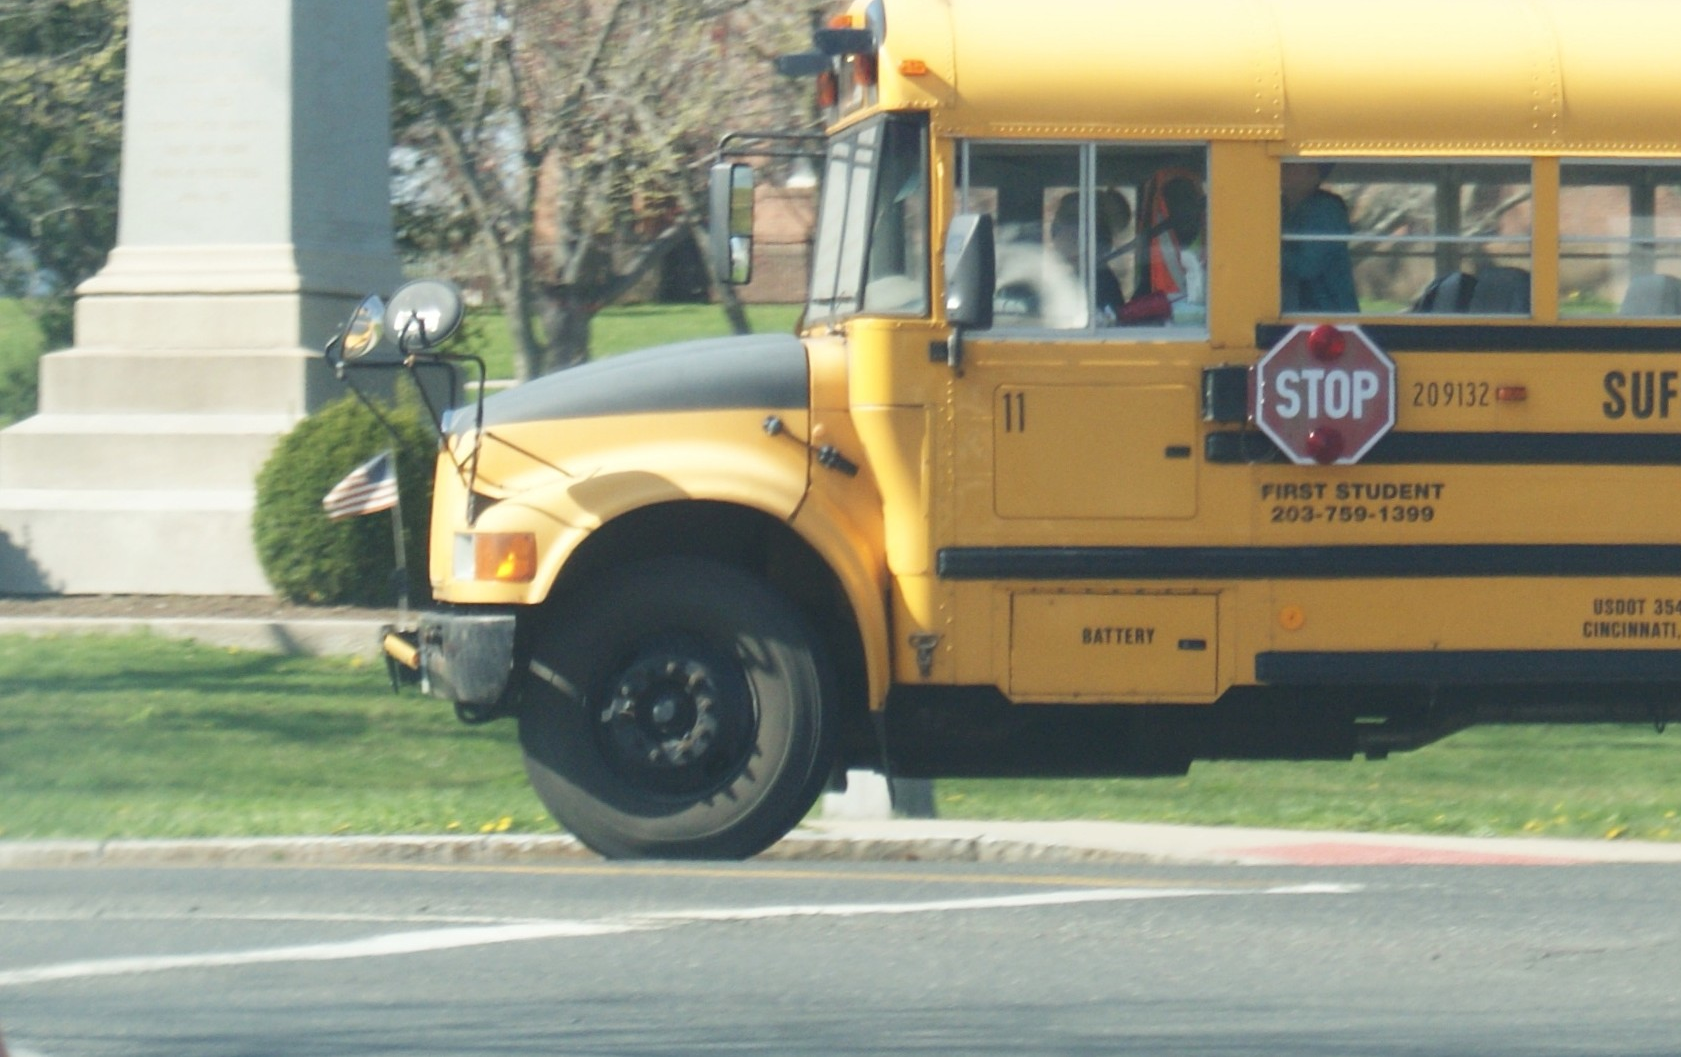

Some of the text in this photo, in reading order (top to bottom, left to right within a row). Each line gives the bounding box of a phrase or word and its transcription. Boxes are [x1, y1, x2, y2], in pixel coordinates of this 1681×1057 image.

[1275, 369, 1379, 420] STOP
[1412, 381, 1490, 407] 209132
[1002, 392, 1025, 433] 11
[1260, 483, 1446, 501] FIRST STUDENT
[1271, 505, 1436, 524] 203-759-1399
[1593, 598, 1647, 616] USDOT
[1082, 627, 1155, 645] BATTERY
[1582, 621, 1681, 640] CINCINNATI,
